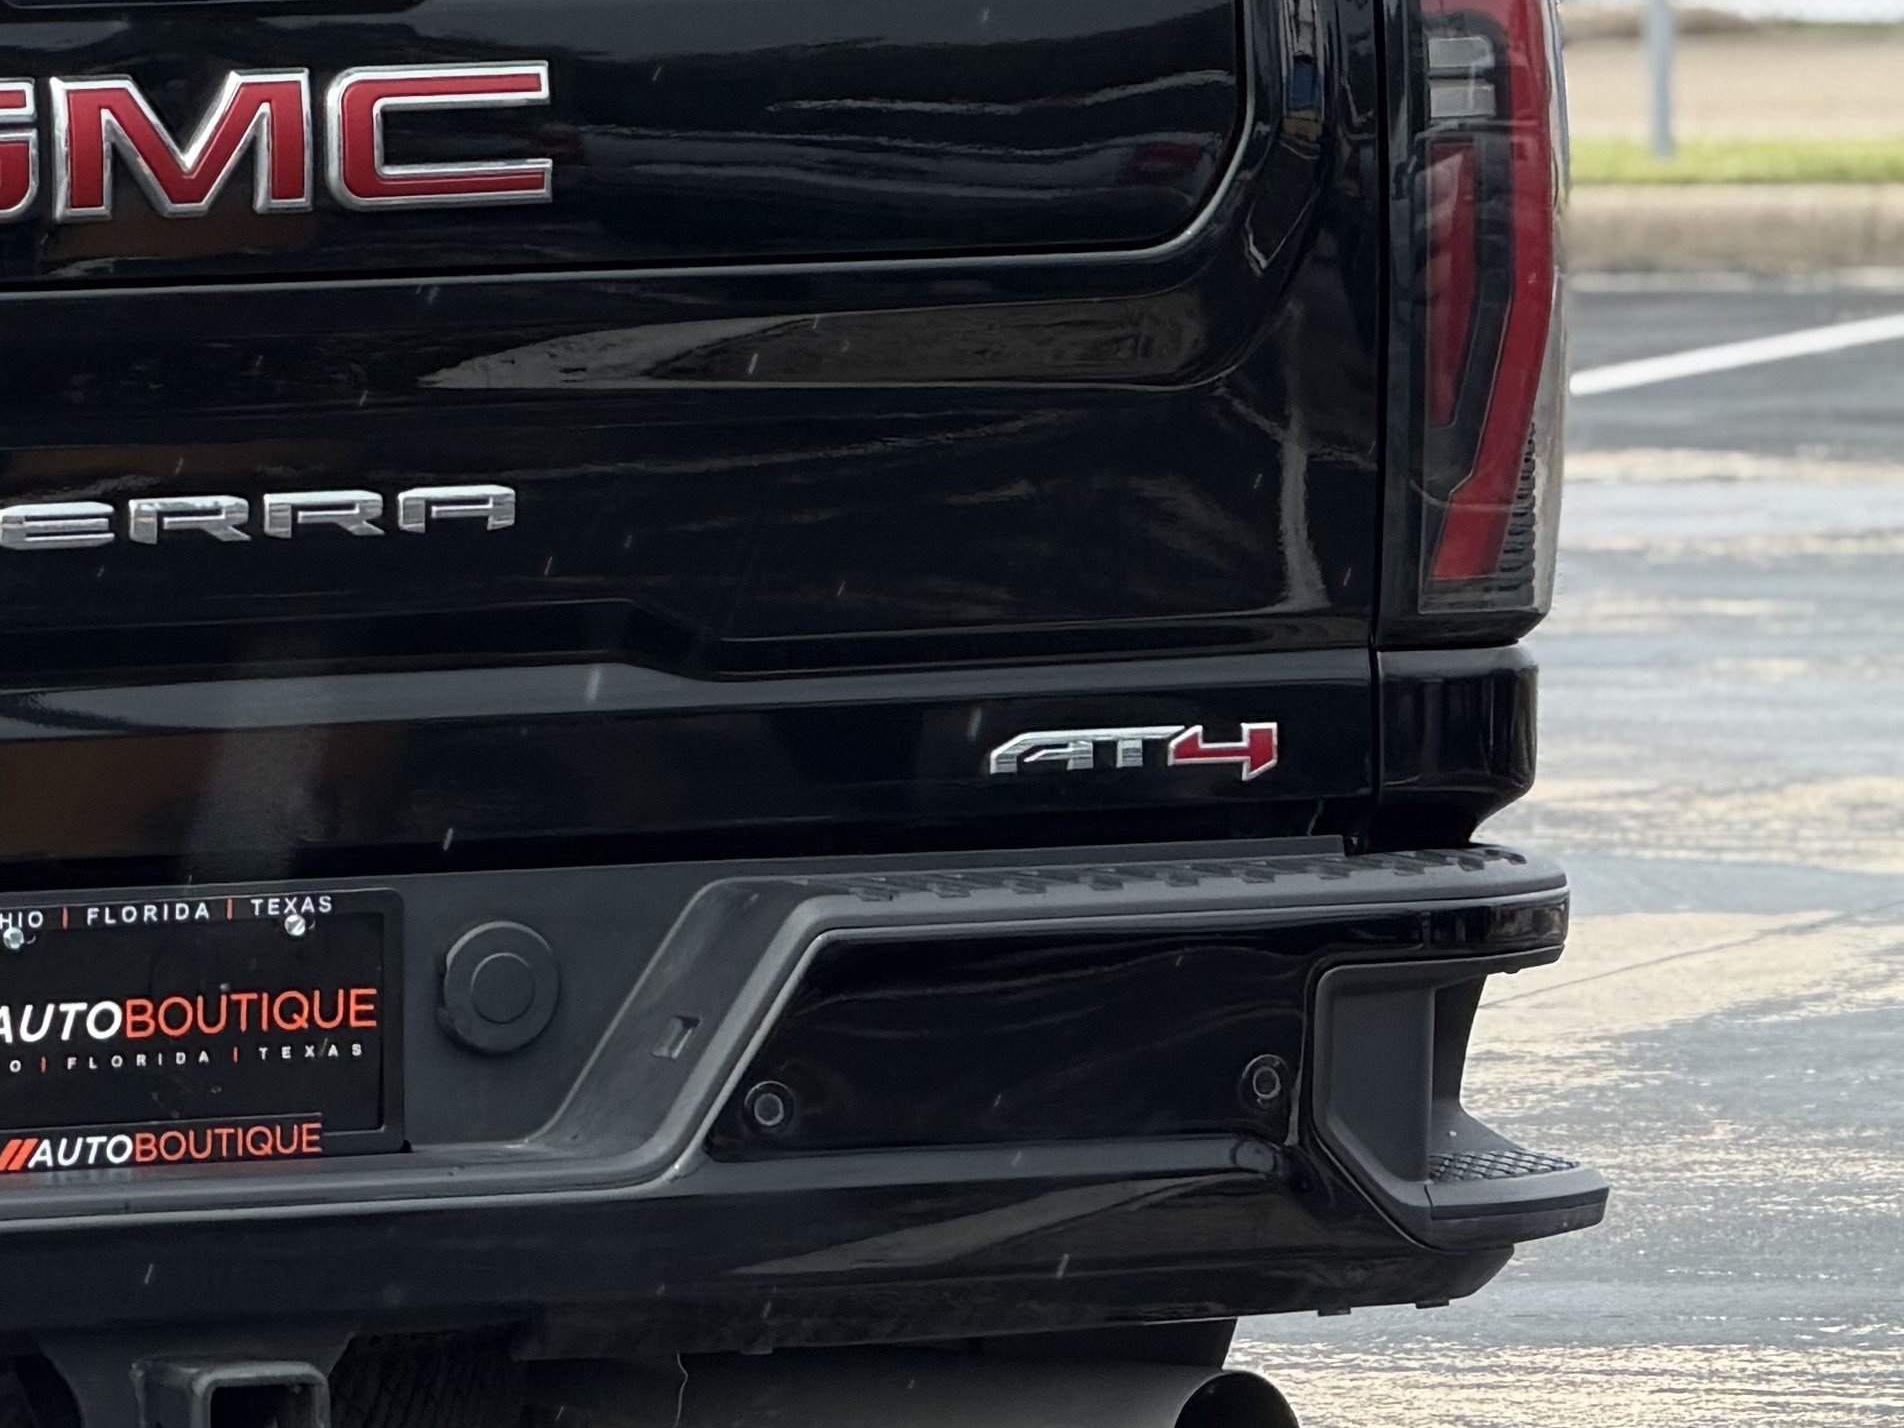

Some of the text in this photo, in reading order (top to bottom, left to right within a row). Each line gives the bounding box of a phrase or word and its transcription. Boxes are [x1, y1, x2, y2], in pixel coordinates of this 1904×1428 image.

[988, 721, 1279, 782] AT4
[86, 902, 211, 926] FLORIDA
[250, 895, 333, 917] TEXAS
[66, 1050, 210, 1071] FLORIDA
[258, 1042, 363, 1062] TEXAS
[27, 1122, 322, 1169] AUTOBOUTIQUE
